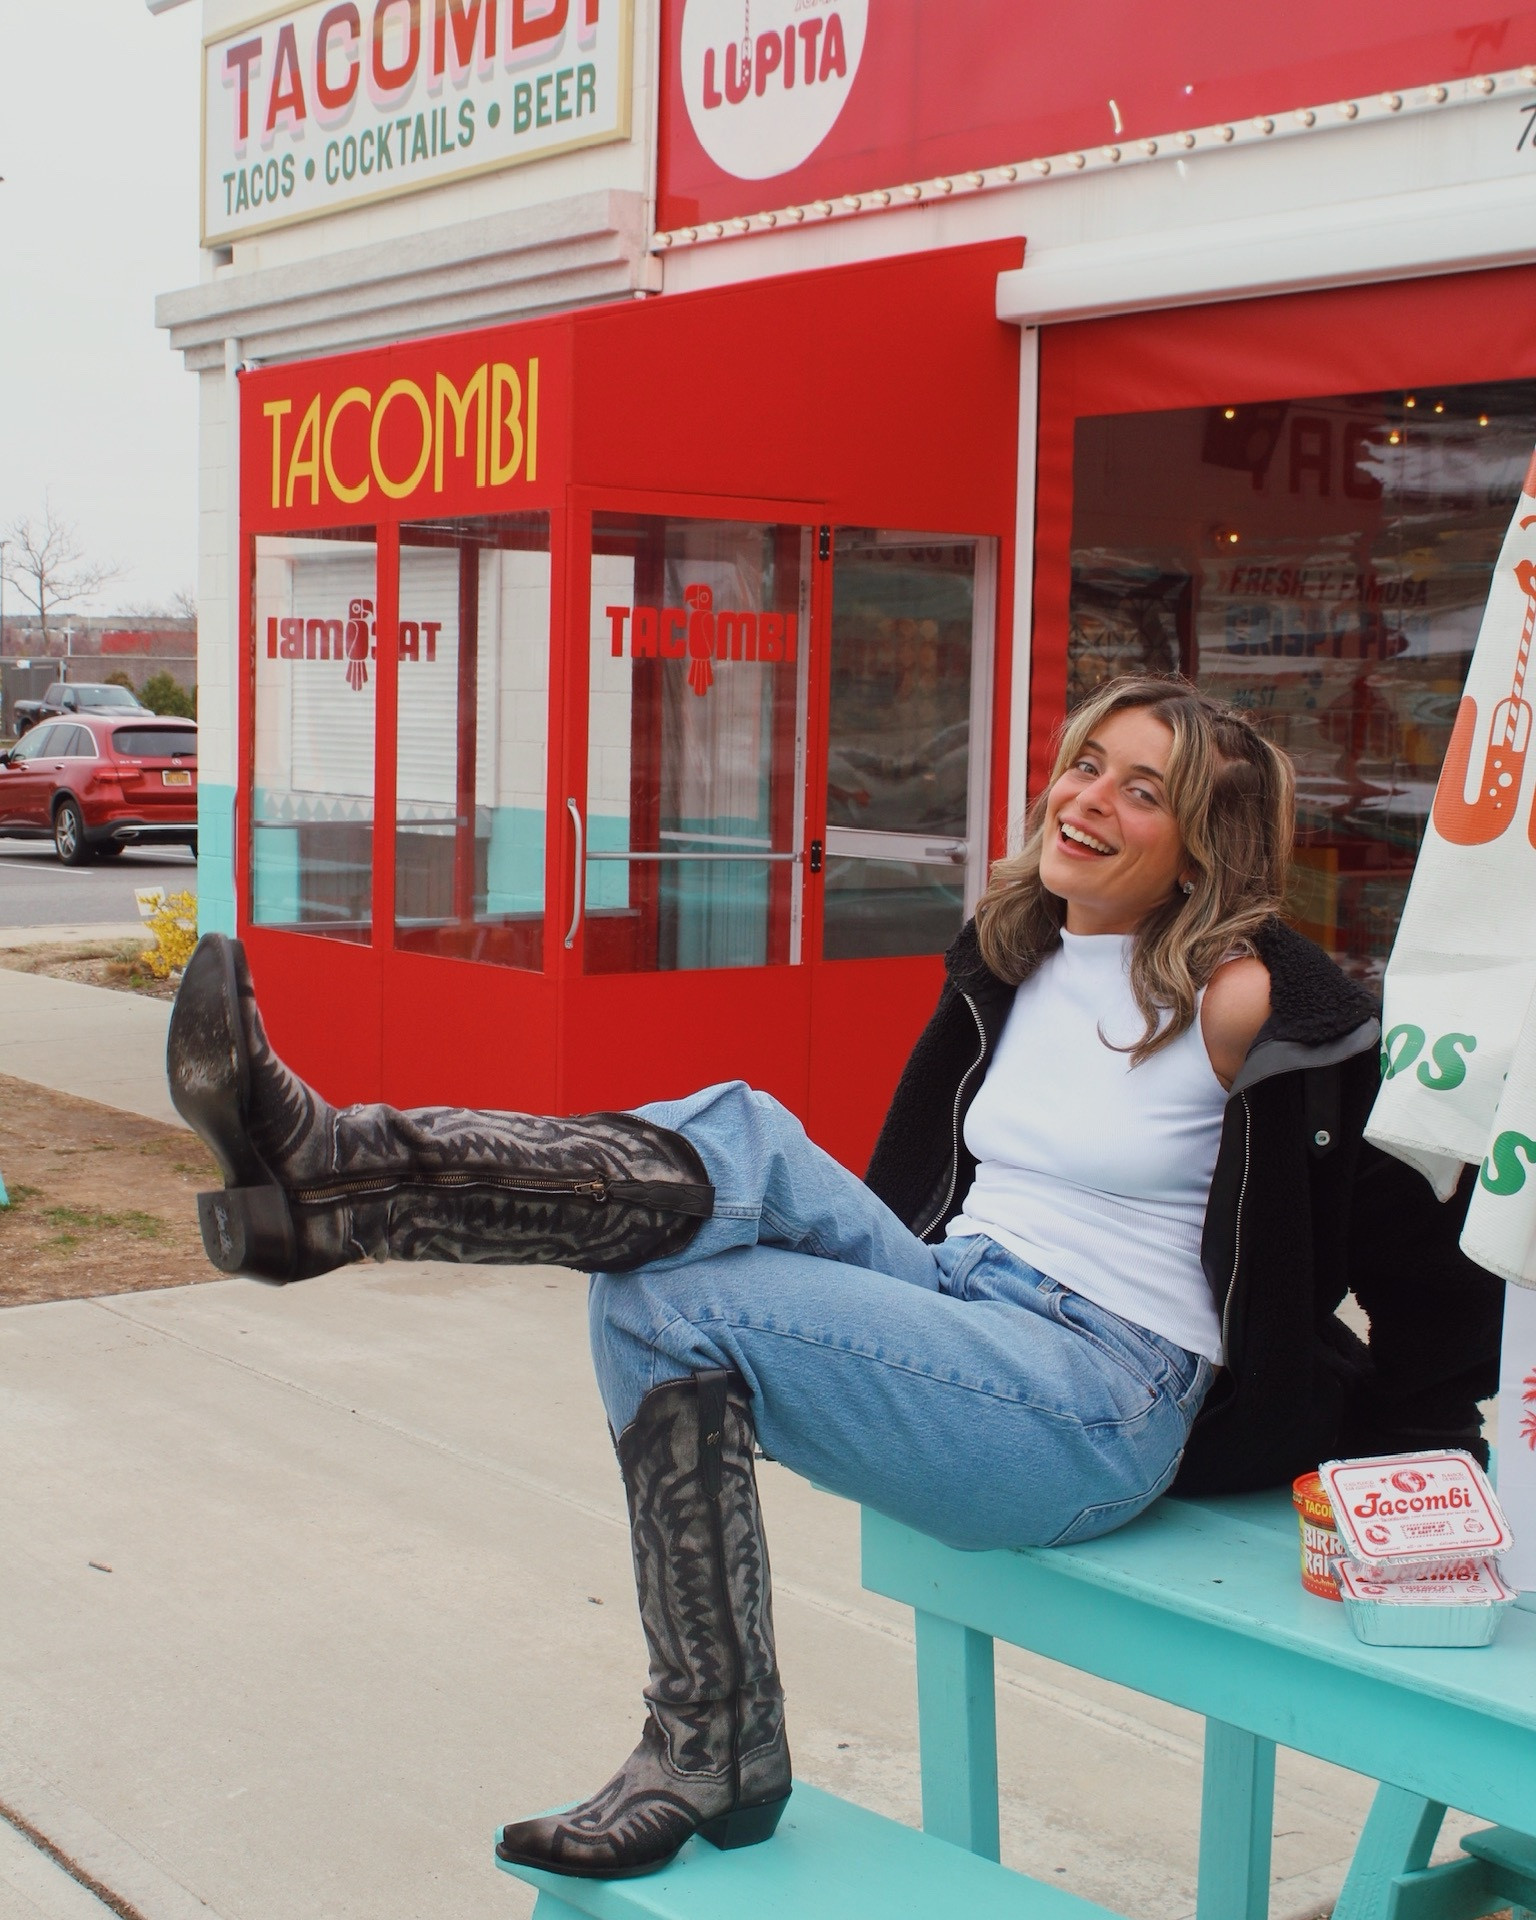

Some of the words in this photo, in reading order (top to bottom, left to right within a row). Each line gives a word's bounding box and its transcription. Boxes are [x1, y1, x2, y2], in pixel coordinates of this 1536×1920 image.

[224, 0, 599, 142] TACOMB
[703, 12, 847, 109] LUPITA
[223, 153, 295, 215] TACOS
[325, 98, 475, 185] COCKTAILS
[513, 62, 596, 135] BEER
[263, 357, 539, 509] TACOMBI
[606, 606, 797, 662] TACOMBI
[1354, 1487, 1472, 1518] Tacombi
